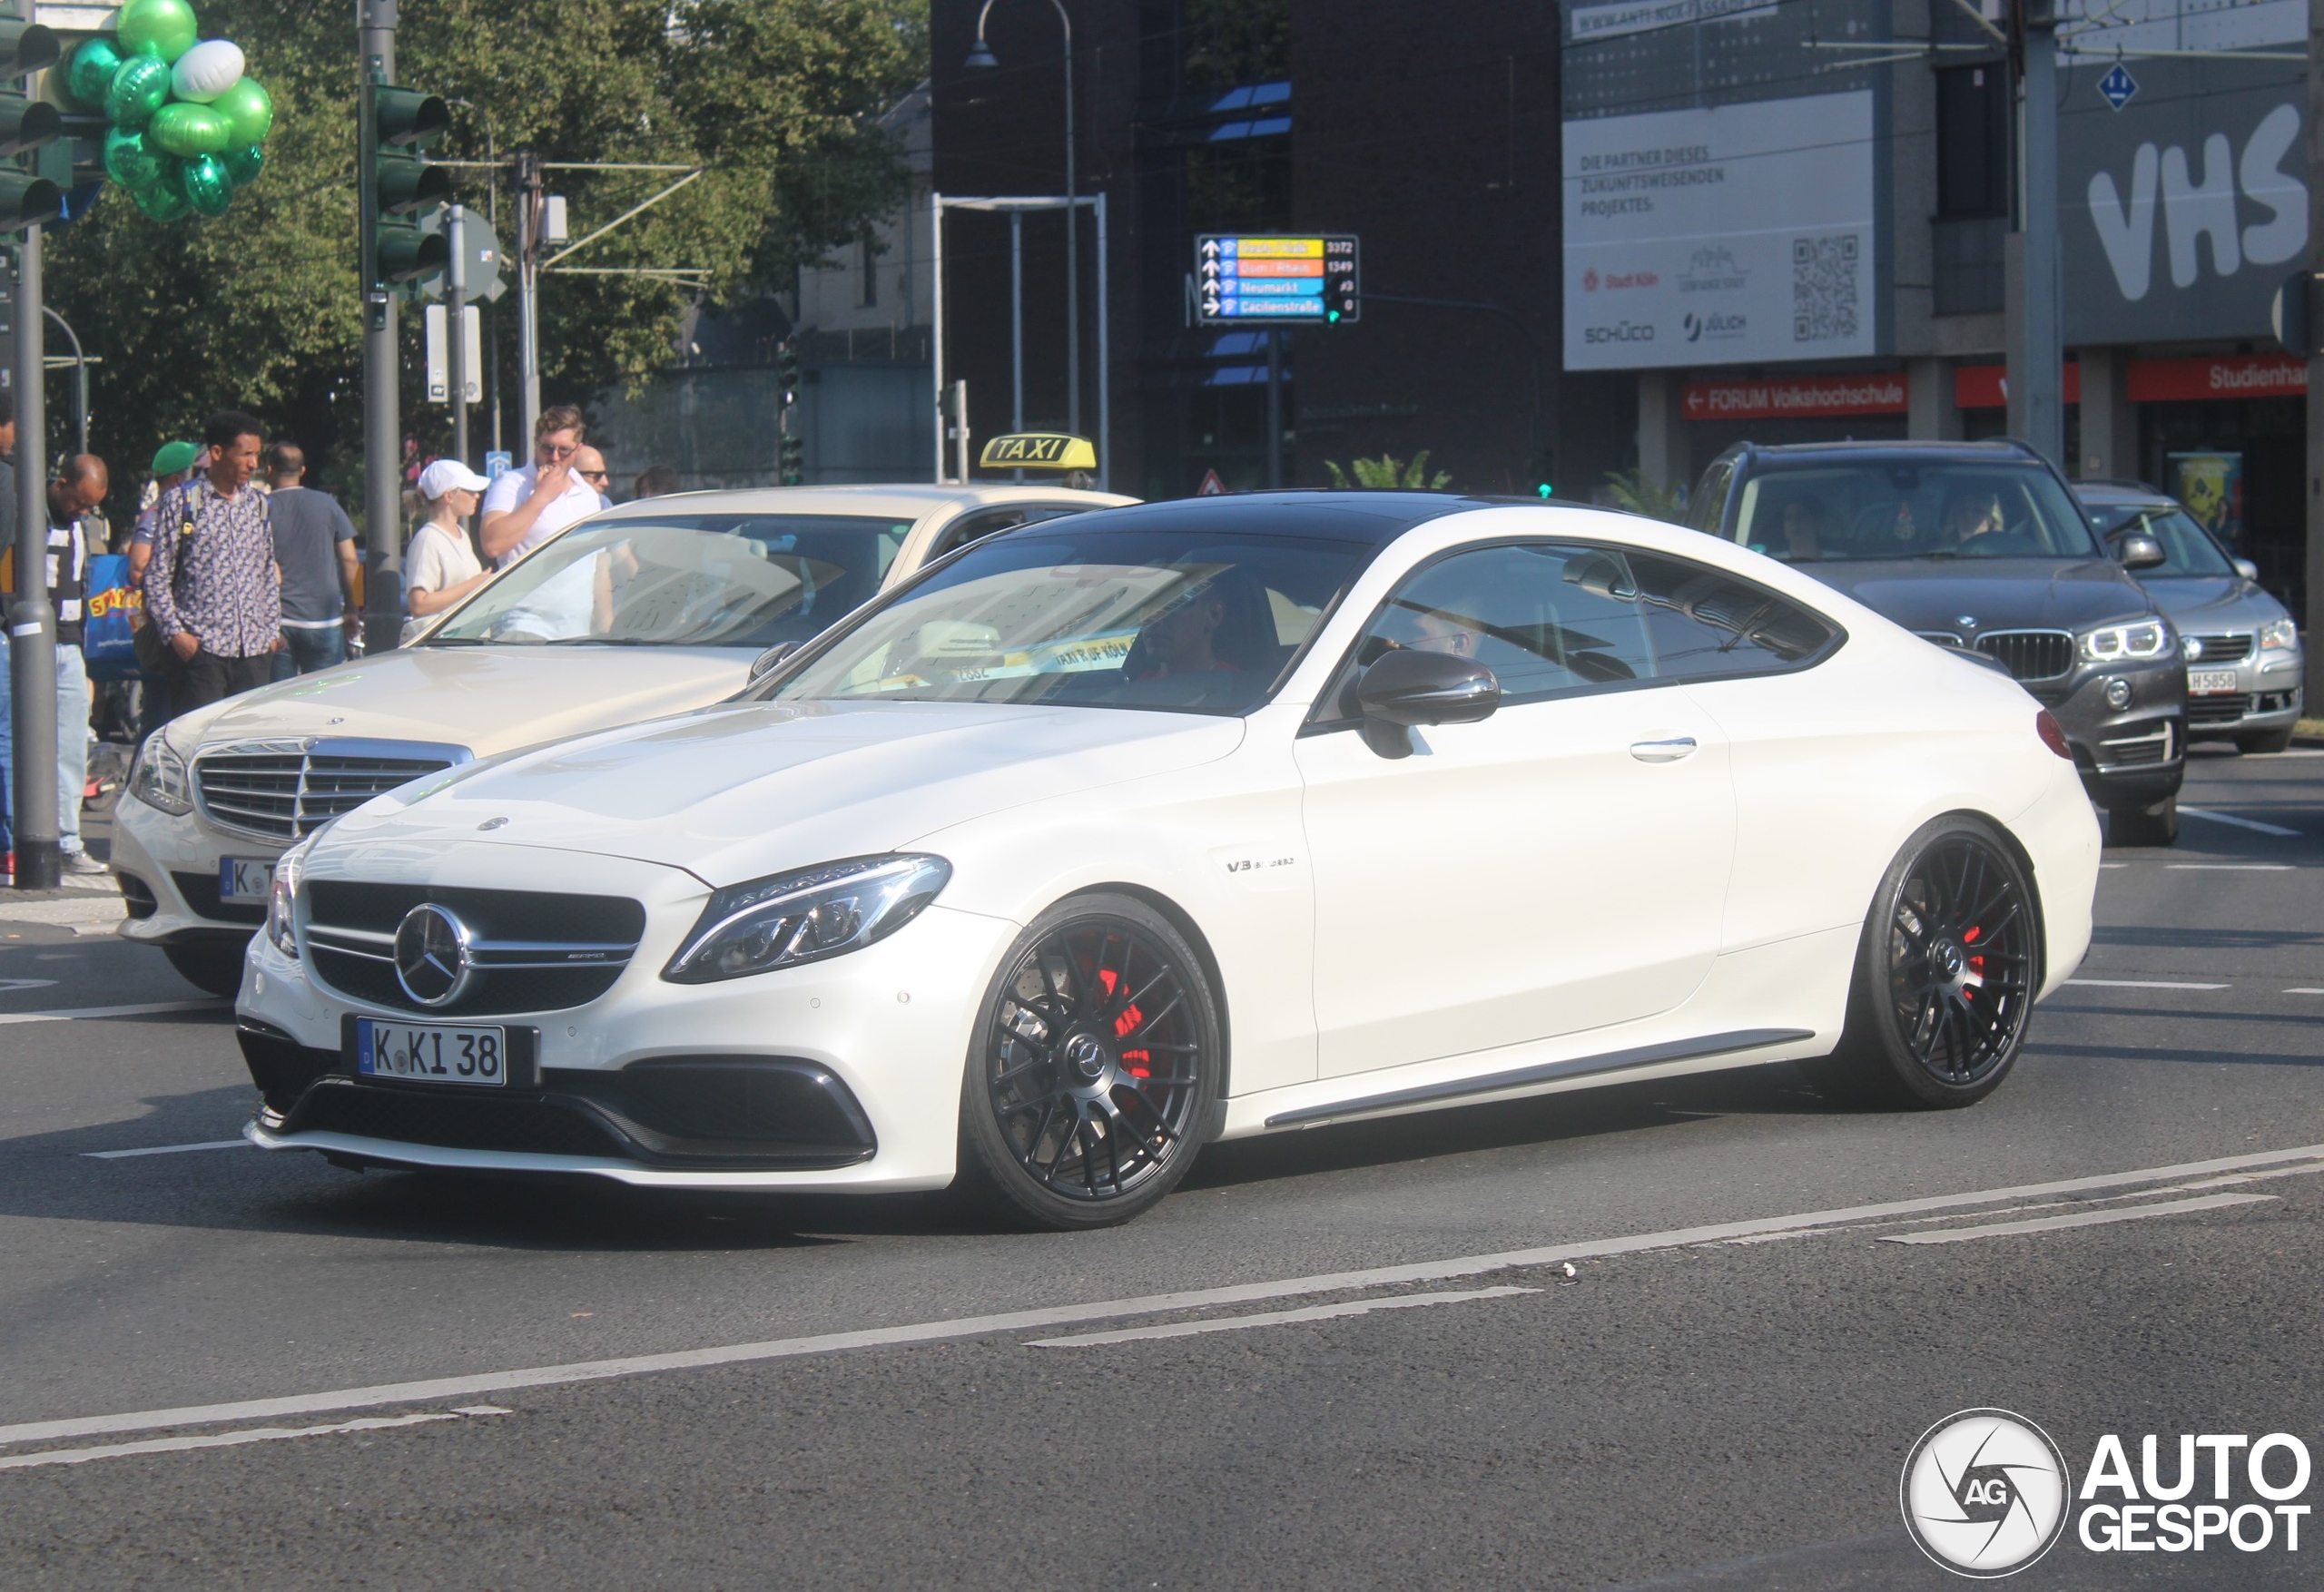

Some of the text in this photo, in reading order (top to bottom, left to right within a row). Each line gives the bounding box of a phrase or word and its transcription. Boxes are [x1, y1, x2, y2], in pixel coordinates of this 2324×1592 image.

[1581, 145, 1709, 171] DIE PARTNER DIESES
[1581, 168, 1724, 194] ZUKUNFTSWEISENDEN
[2089, 103, 2309, 300] VHS
[1327, 241, 1353, 253] 3372
[1241, 281, 1298, 293] Neumarkt
[1241, 300, 1320, 312] Cäcilienstraße
[1585, 320, 1655, 344] SCHÜCO
[1709, 382, 1904, 411] FORUM Volkshochschule
[997, 439, 1061, 459] TAXI
[235, 863, 249, 892] K
[375, 1027, 393, 1070] K
[409, 1031, 448, 1074] KI
[457, 1035, 498, 1077] 38
